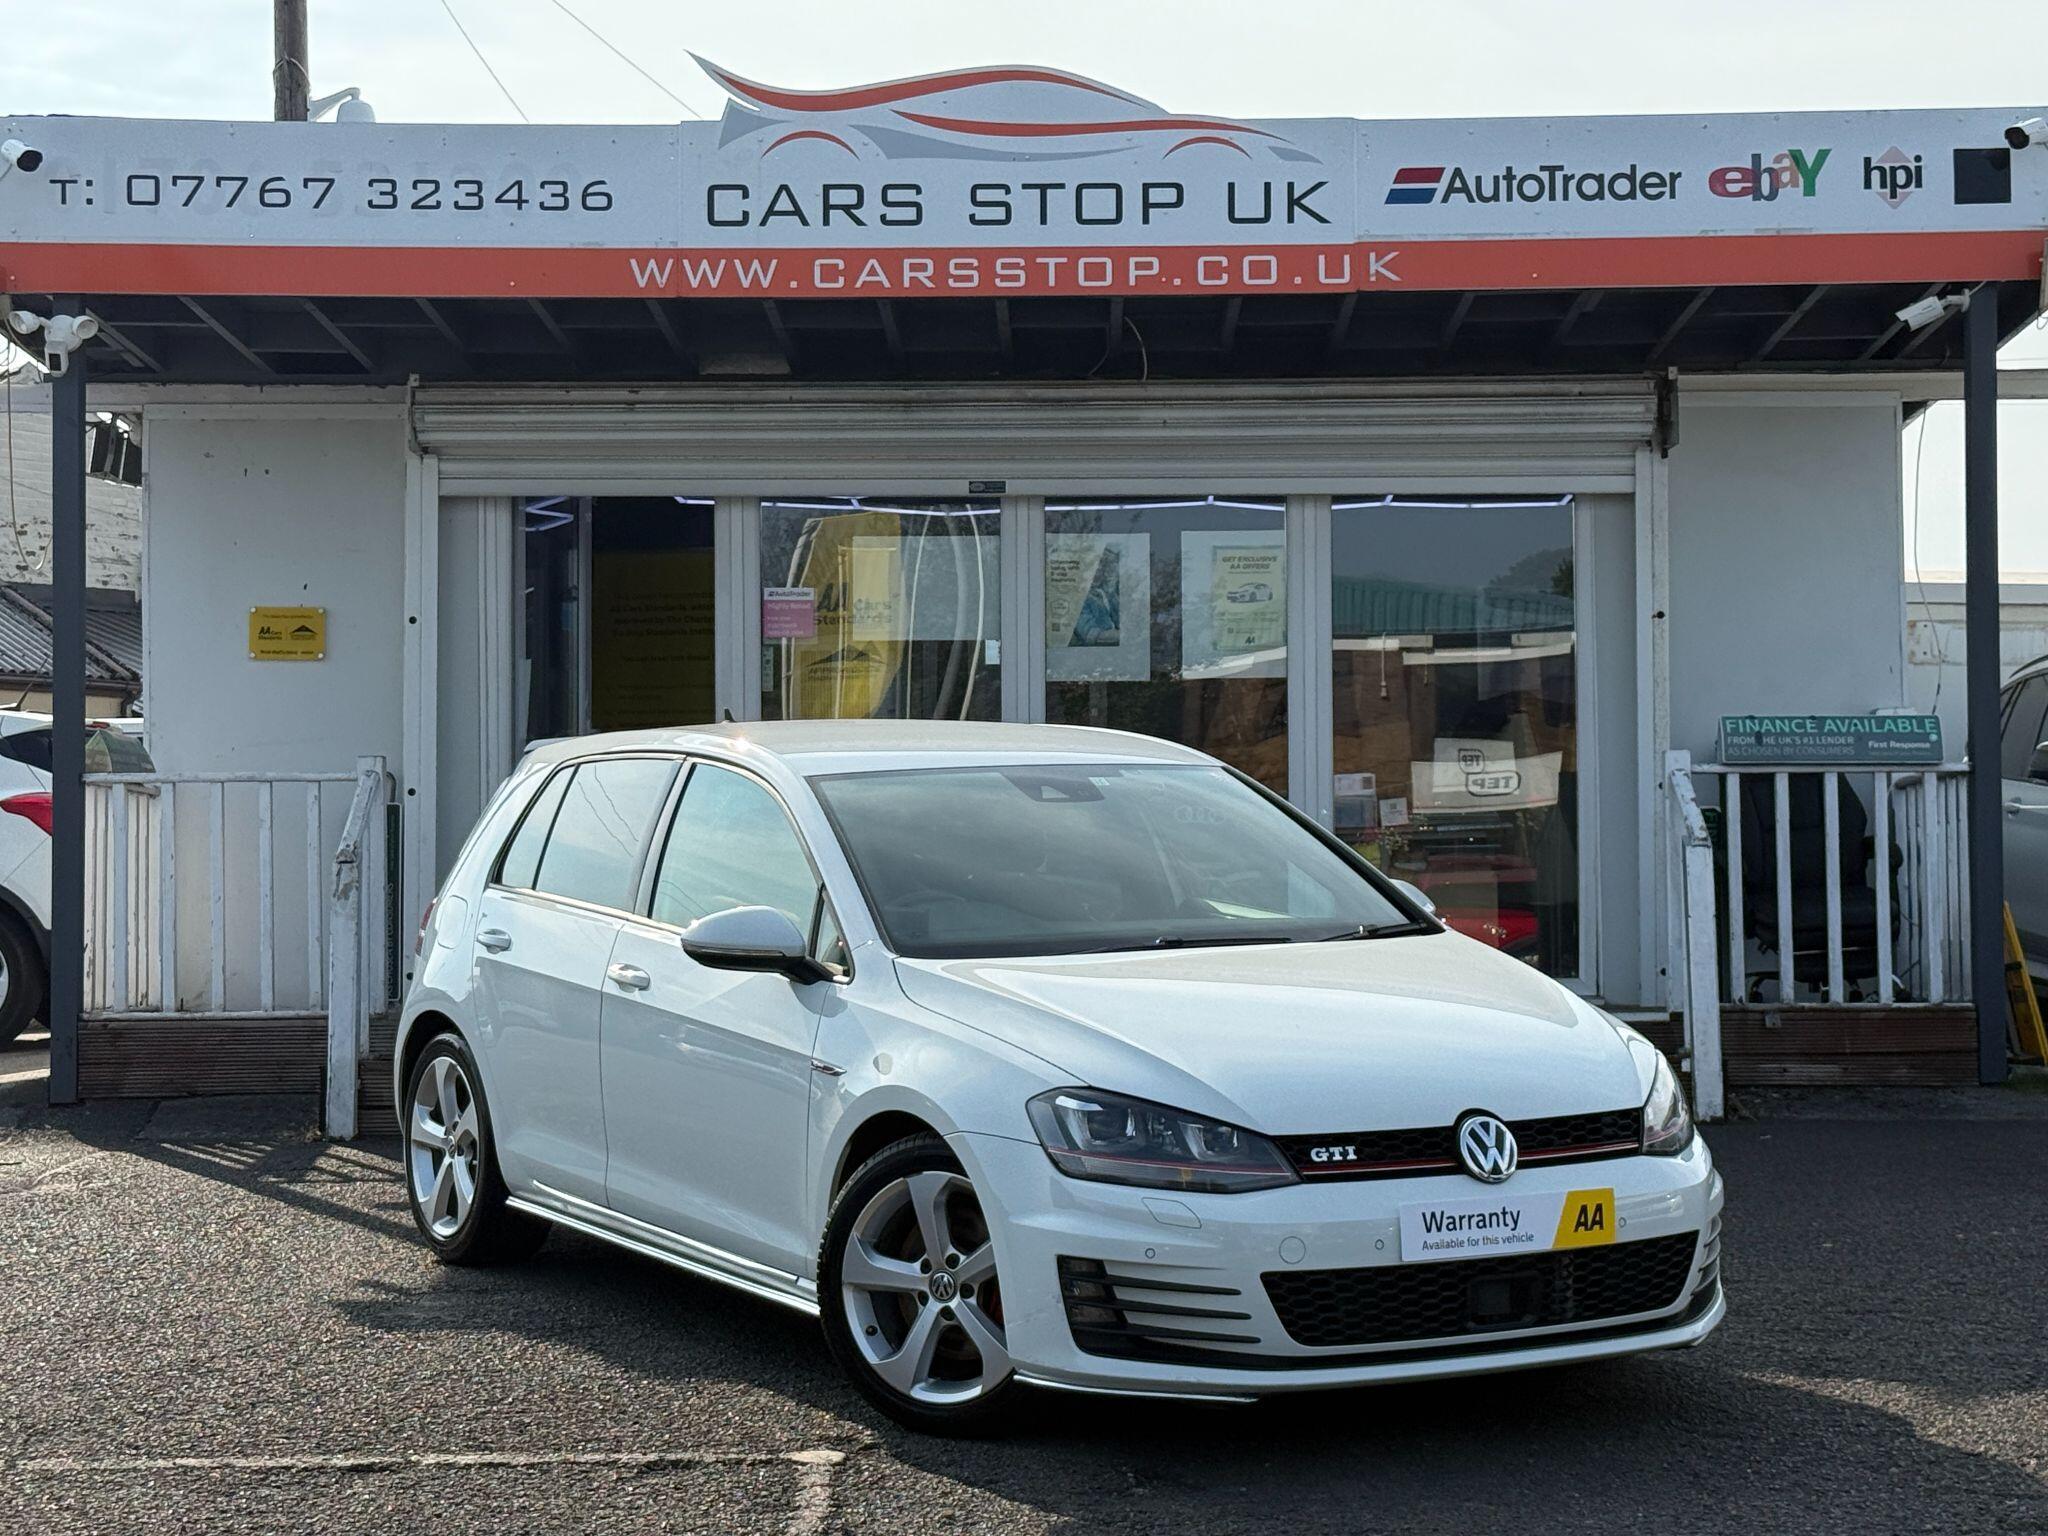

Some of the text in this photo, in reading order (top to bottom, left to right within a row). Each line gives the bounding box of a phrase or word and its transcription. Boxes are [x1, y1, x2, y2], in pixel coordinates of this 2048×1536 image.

[1441, 163, 1682, 204] AutoTrader
[1863, 154, 1924, 201] hpi
[50, 174, 614, 212] T: 07767 323436
[706, 181, 1332, 228] CARS STOP UK
[1725, 718, 1938, 734] FINANCE AVAILABLE
[1727, 735, 1755, 745] FROM
[1757, 735, 1776, 745] HE
[1816, 735, 1855, 745] LENDER
[1868, 740, 1931, 750] First Response
[1310, 1145, 1358, 1163] GTI
[1421, 1205, 1521, 1234] Warranty
[1573, 1202, 1605, 1233] AA
[1422, 1231, 1535, 1251] Available for this vehicle
